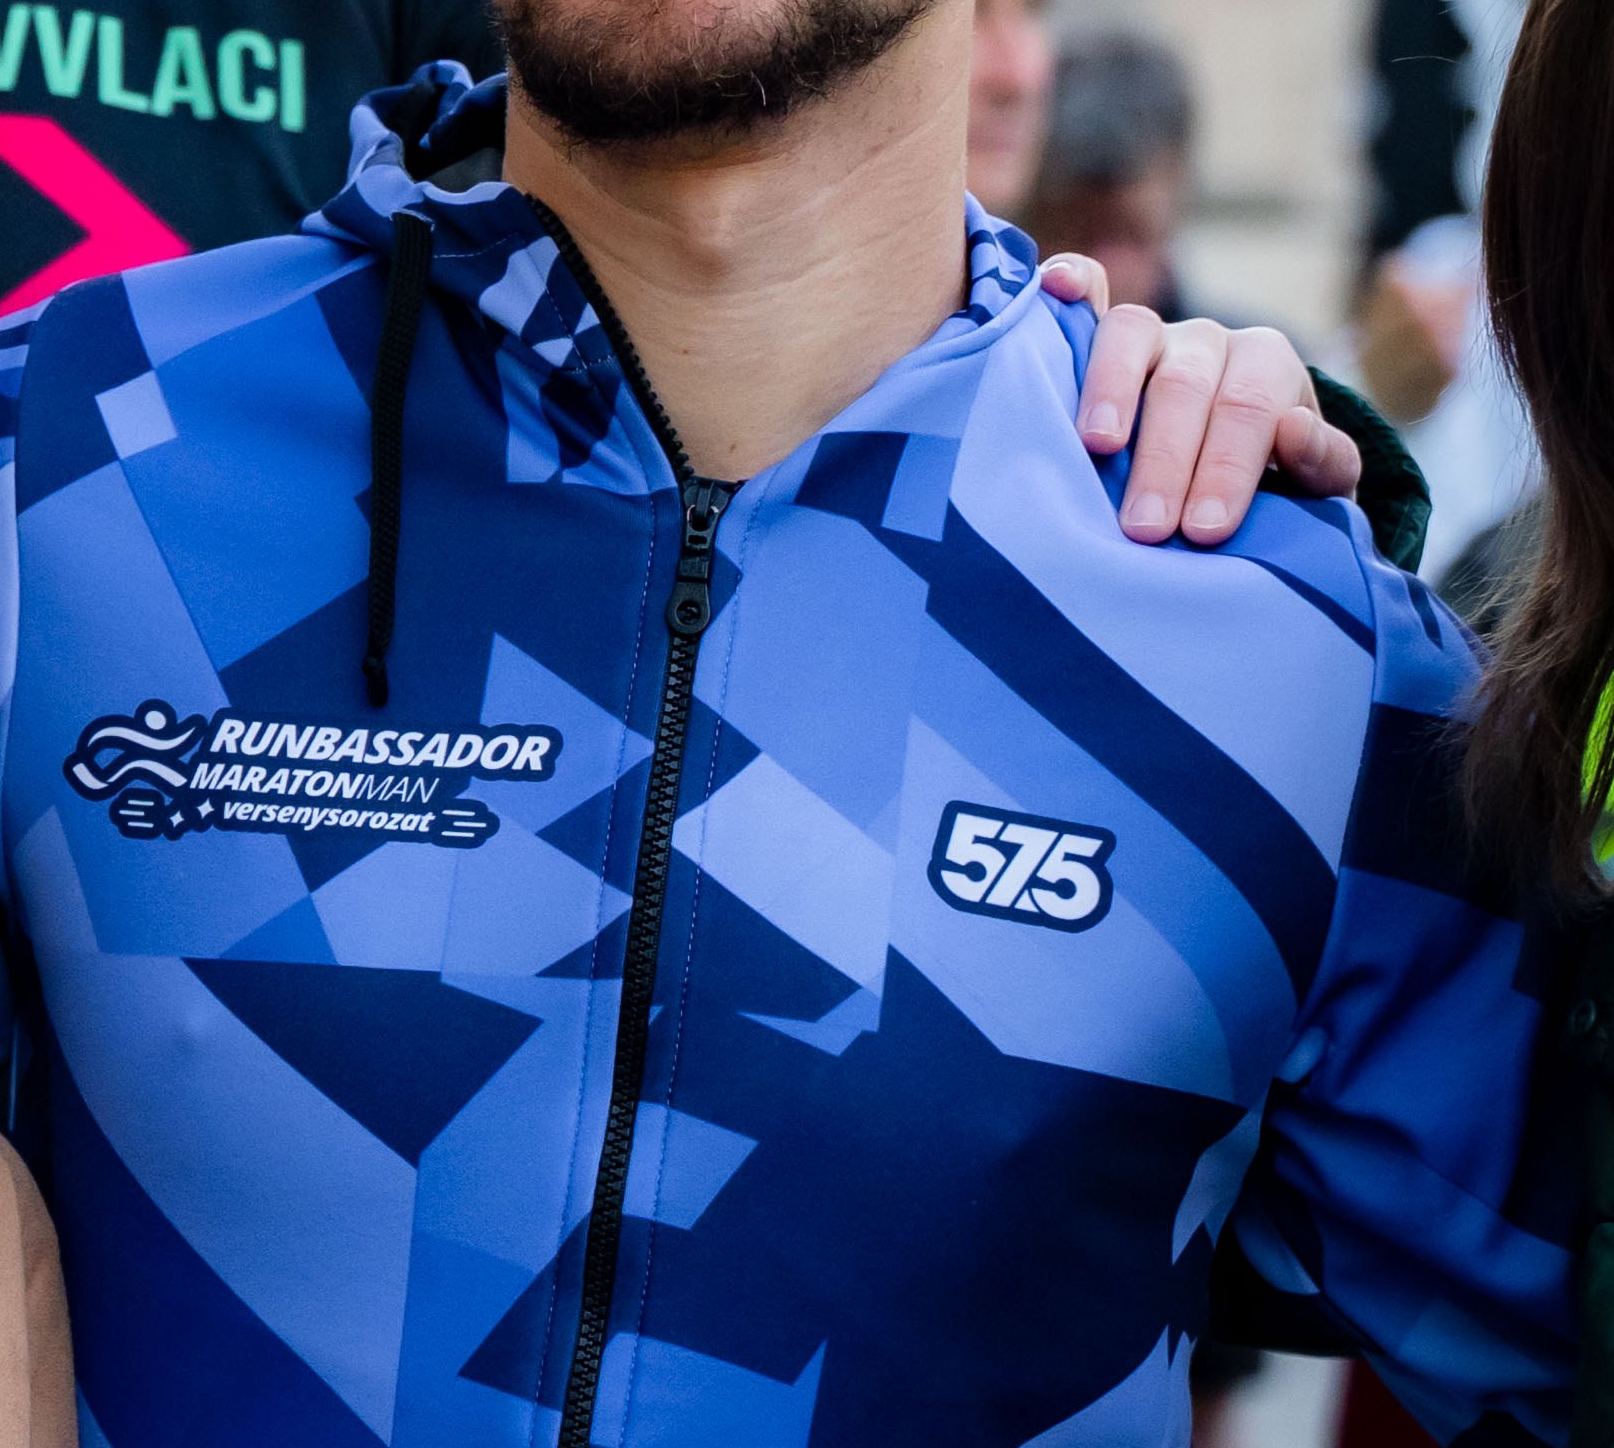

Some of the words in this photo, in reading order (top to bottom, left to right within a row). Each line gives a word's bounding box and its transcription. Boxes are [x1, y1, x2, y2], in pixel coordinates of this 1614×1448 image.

[210, 717, 552, 772] RUNBASSADOR
[190, 762, 441, 804] MARATONMAN
[223, 799, 437, 833] versenysorozat
